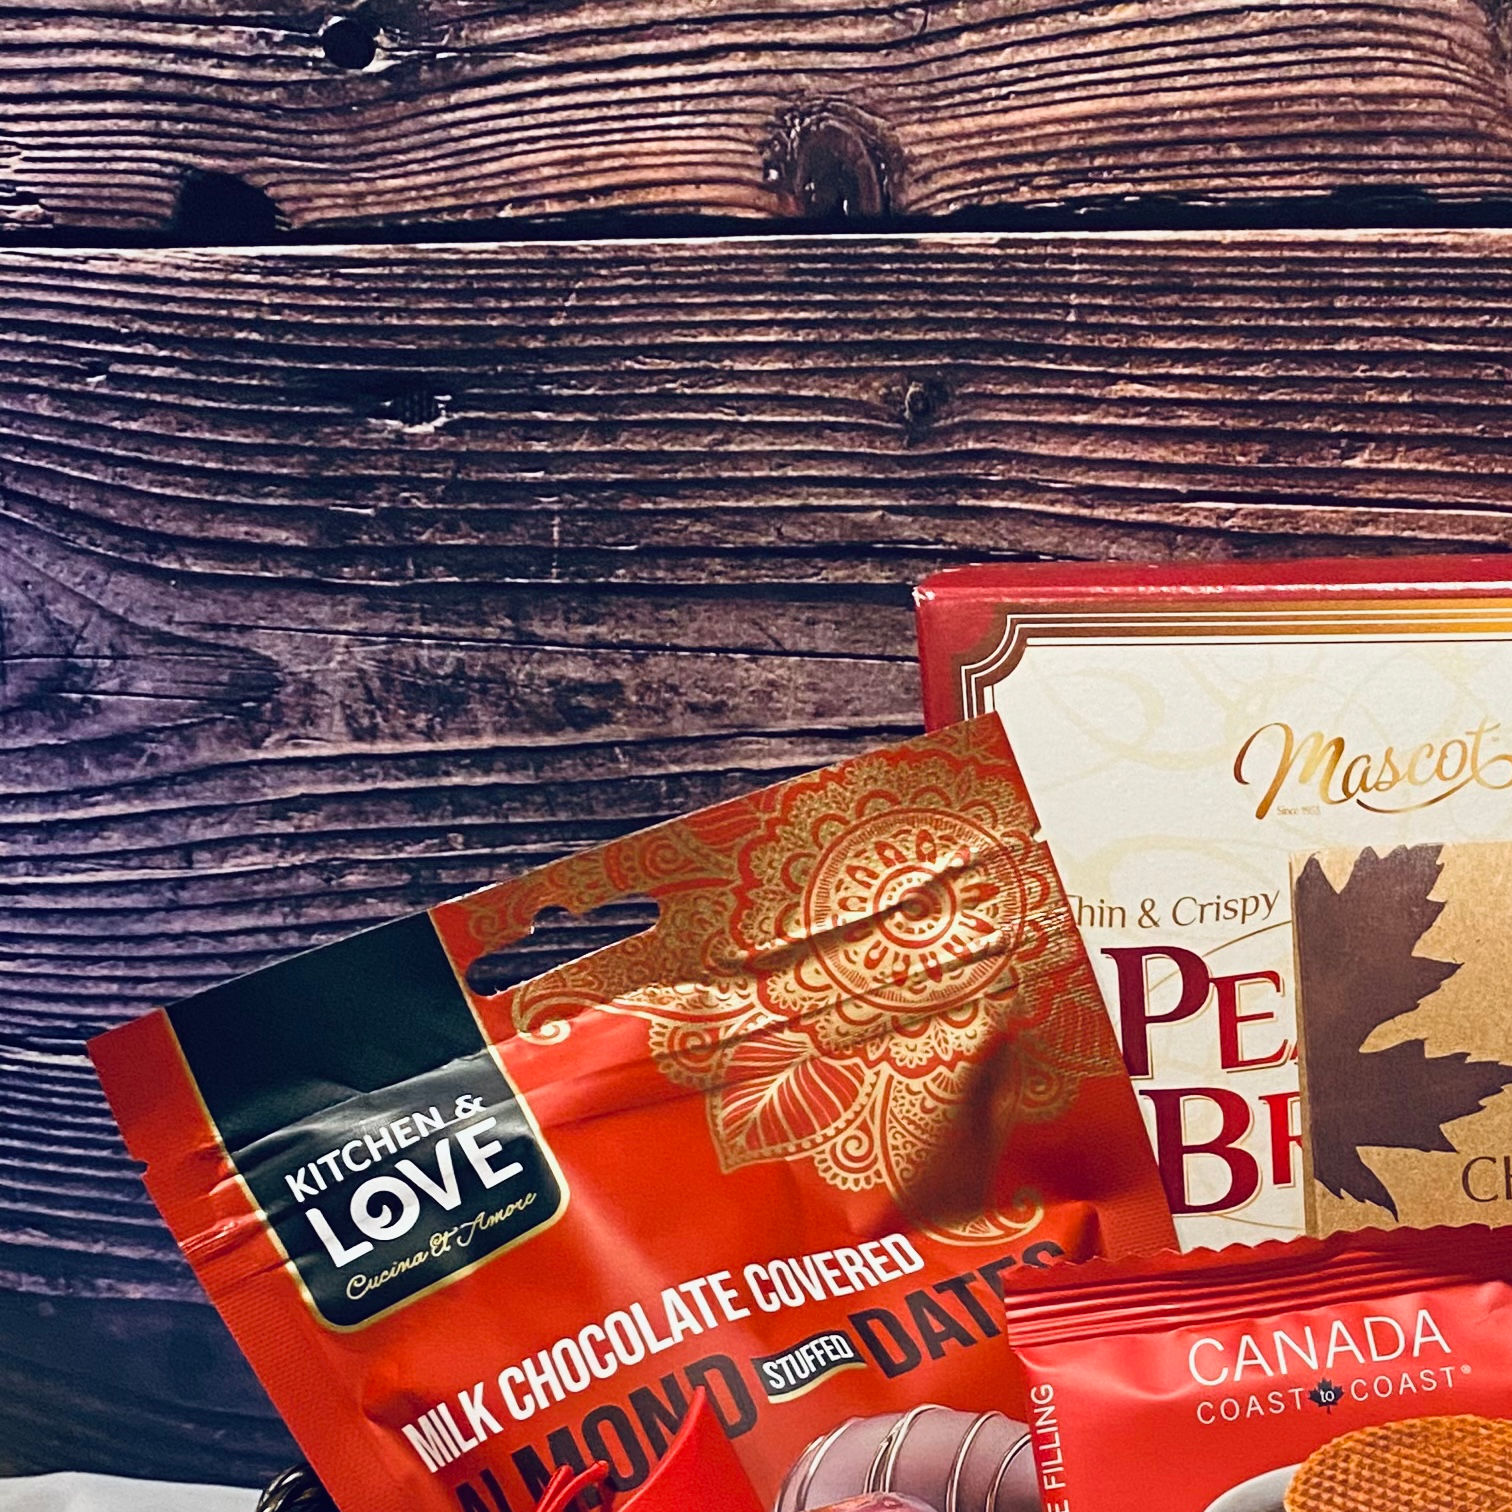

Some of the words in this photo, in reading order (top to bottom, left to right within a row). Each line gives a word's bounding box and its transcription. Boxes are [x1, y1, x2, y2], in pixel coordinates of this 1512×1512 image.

[1067, 895, 1126, 928] hin
[1137, 897, 1160, 928] &
[1172, 890, 1280, 926] Crispy
[1101, 945, 1299, 1079] PE
[284, 1106, 446, 1203] KITCHEN
[454, 1094, 487, 1120] &
[305, 1116, 524, 1268] LOVE
[346, 1250, 429, 1300] Cucina
[457, 1192, 537, 1247] Amore
[401, 1380, 504, 1474] MILK
[497, 1269, 750, 1423] CHOCOLATE
[747, 1232, 925, 1315] COVERED
[762, 1333, 854, 1391] STUFFED
[1189, 1309, 1452, 1386] CANADA
[1030, 1383, 1066, 1491] FILLING
[1196, 1388, 1304, 1425] COAST
[1320, 1389, 1335, 1402] to
